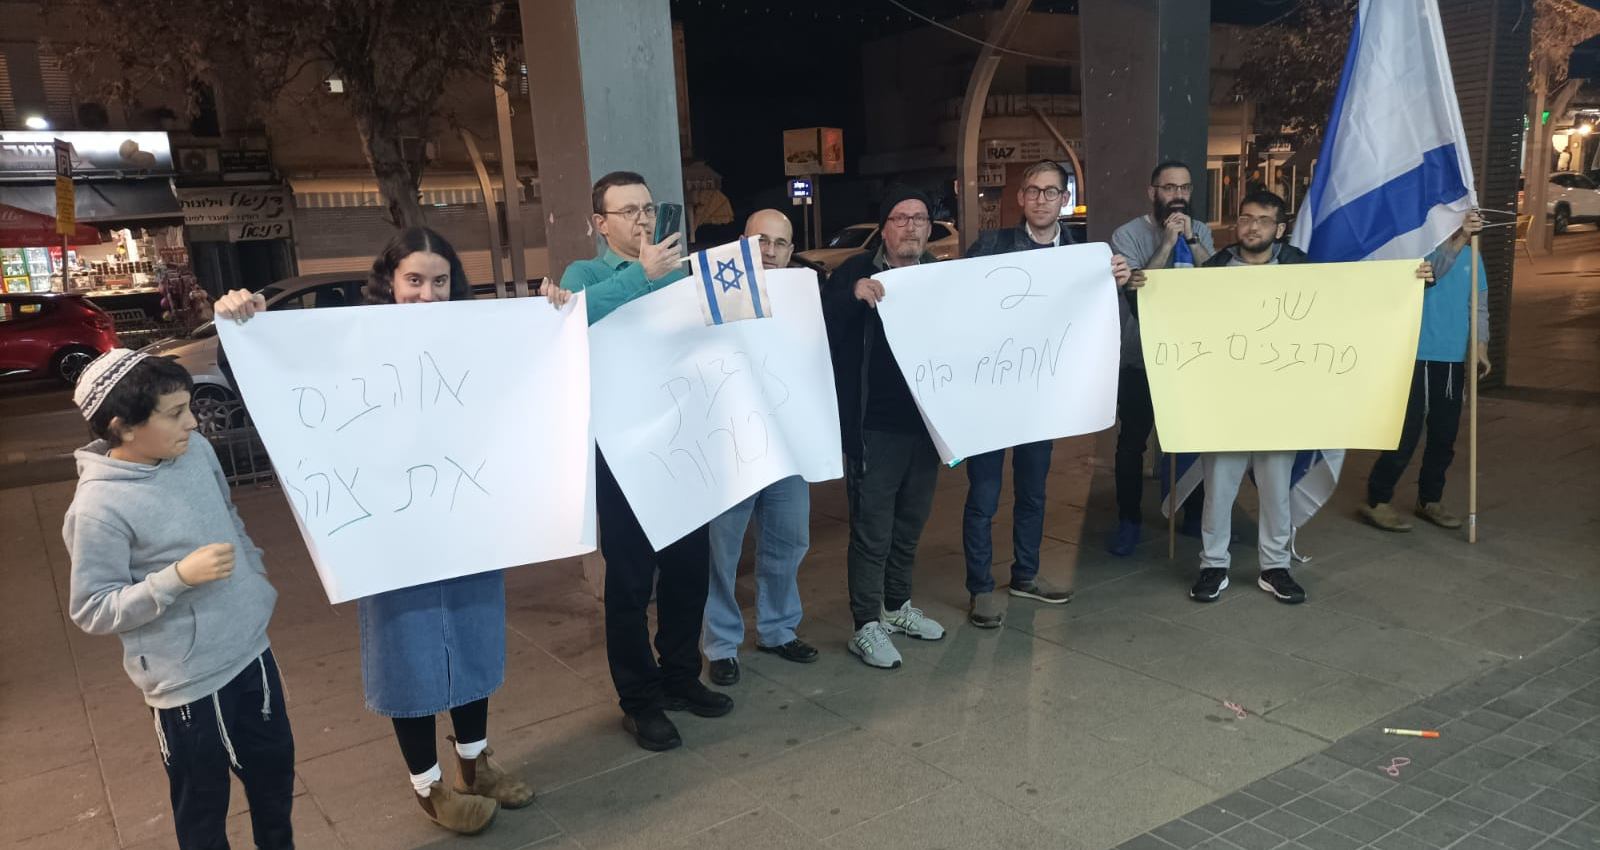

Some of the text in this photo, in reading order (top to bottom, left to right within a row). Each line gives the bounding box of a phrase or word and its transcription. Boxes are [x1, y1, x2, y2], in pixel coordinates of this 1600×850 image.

[985, 266, 1048, 310] 2
[1256, 290, 1318, 332] שני
[394, 456, 491, 514] את
